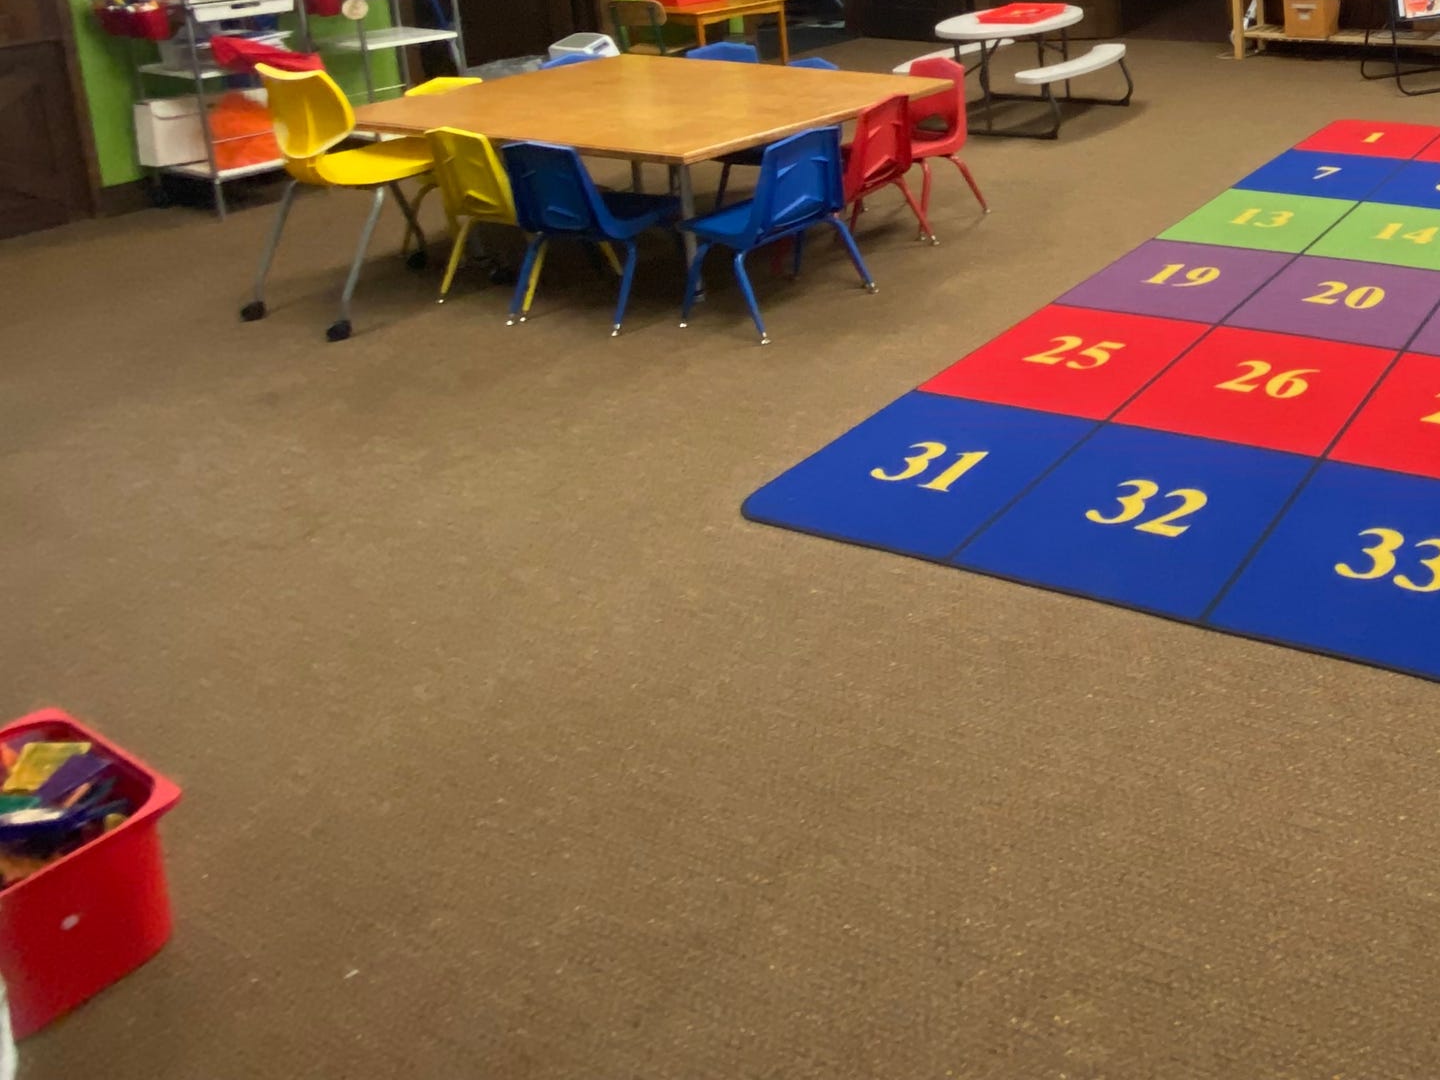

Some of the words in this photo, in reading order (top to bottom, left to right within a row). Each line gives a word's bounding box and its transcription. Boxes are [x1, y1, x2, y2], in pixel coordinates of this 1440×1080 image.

[1360, 132, 1385, 143] 1
[1313, 166, 1341, 179] 7
[1229, 209, 1293, 226] 13
[1376, 223, 1438, 243] 14
[1147, 264, 1220, 286] 19
[1303, 281, 1384, 308] 20
[1023, 335, 1126, 369] 25
[1216, 361, 1317, 398] 26
[869, 440, 989, 492] 31
[1086, 480, 1207, 537] 32
